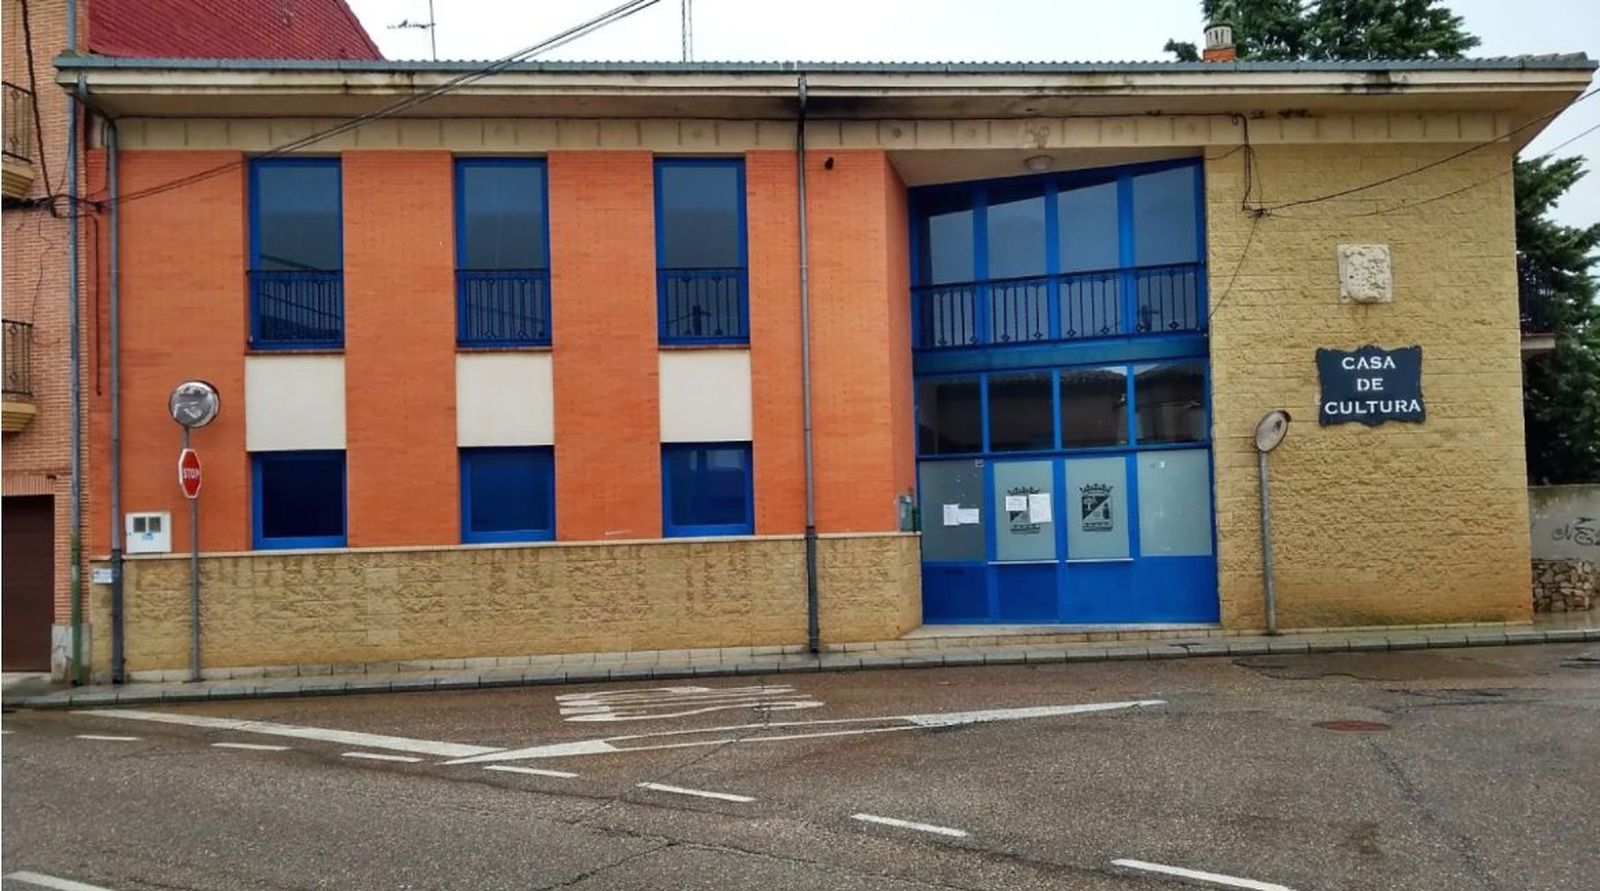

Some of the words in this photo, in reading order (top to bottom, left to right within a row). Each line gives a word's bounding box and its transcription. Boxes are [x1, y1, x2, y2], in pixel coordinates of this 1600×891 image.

[1341, 356, 1396, 370] CASA
[1356, 378, 1384, 391] DE
[1324, 399, 1421, 415] CULTURA
[183, 467, 200, 479] STOP
